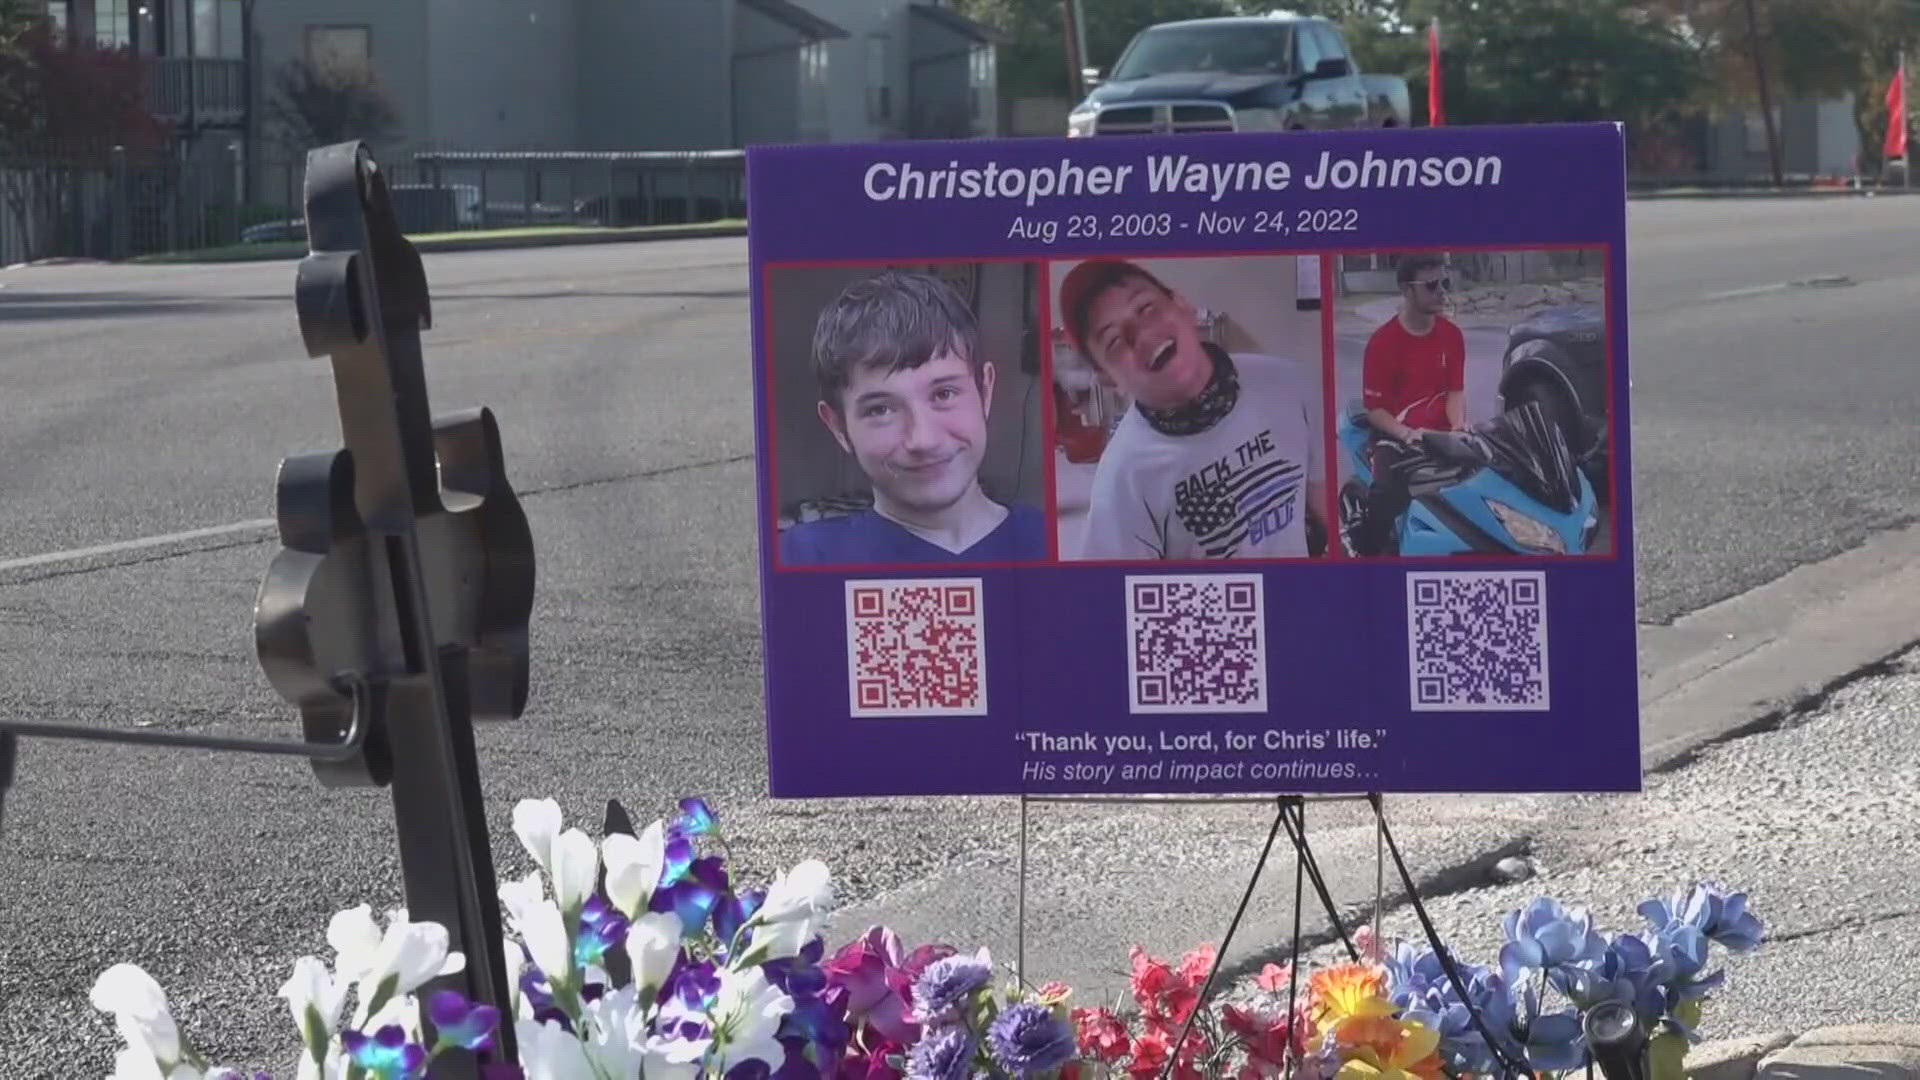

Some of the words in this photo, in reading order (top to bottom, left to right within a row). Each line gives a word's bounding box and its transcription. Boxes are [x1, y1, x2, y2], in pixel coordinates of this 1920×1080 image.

[863, 158, 1133, 207] Christopher
[1147, 155, 1291, 202] Wayne
[1304, 150, 1502, 190] Johnson
[1007, 216, 1058, 244] Aug
[1067, 215, 1103, 240] 23,
[1110, 213, 1171, 236] 2003
[1197, 211, 1246, 234] Nov
[1253, 211, 1290, 235] 24,
[1296, 209, 1358, 232] 2022
[1174, 455, 1232, 505] BACK
[1234, 429, 1276, 467] THE
[1015, 731, 1097, 751] “Thank
[1104, 735, 1153, 756] you,
[1160, 731, 1218, 752] Lord,
[1224, 730, 1257, 750] for
[1022, 761, 1056, 780] His
[1063, 763, 1115, 785] story
[1122, 761, 1163, 780] and
[1170, 761, 1244, 783] impact
